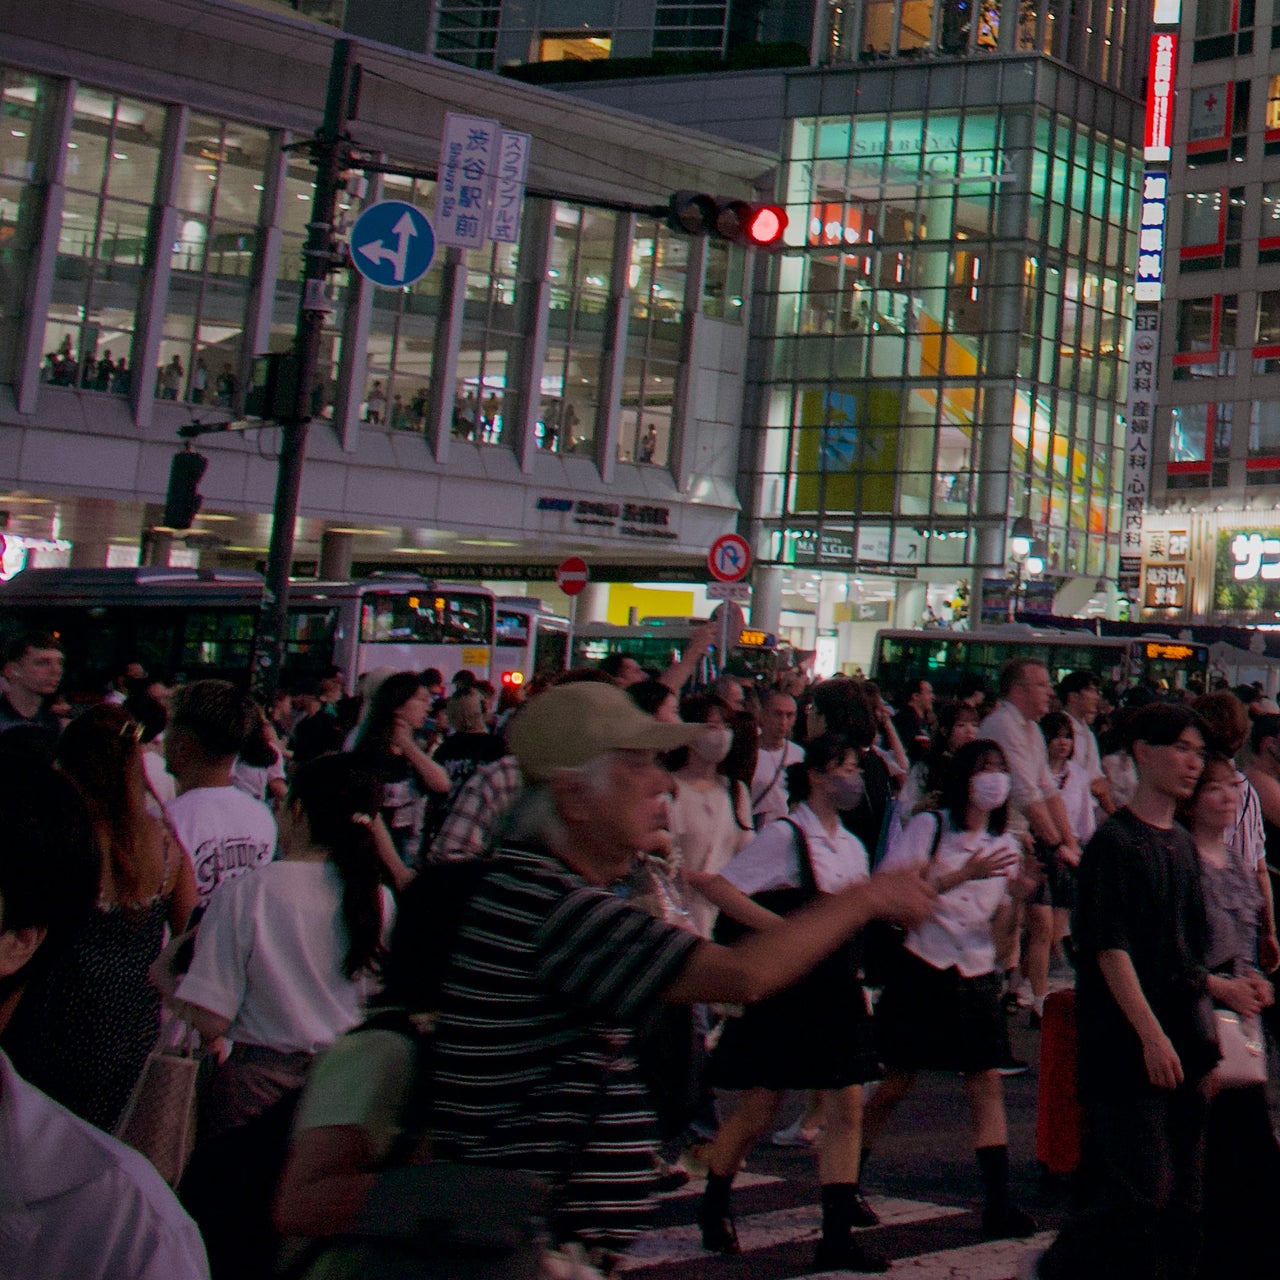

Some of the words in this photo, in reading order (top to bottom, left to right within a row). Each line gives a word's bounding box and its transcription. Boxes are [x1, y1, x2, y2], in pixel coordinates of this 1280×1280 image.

[929, 153, 1022, 176] CITY
[455, 127, 490, 238] 渋谷駅前
[1134, 360, 1151, 393] 内科
[1169, 535, 1188, 556] 2F
